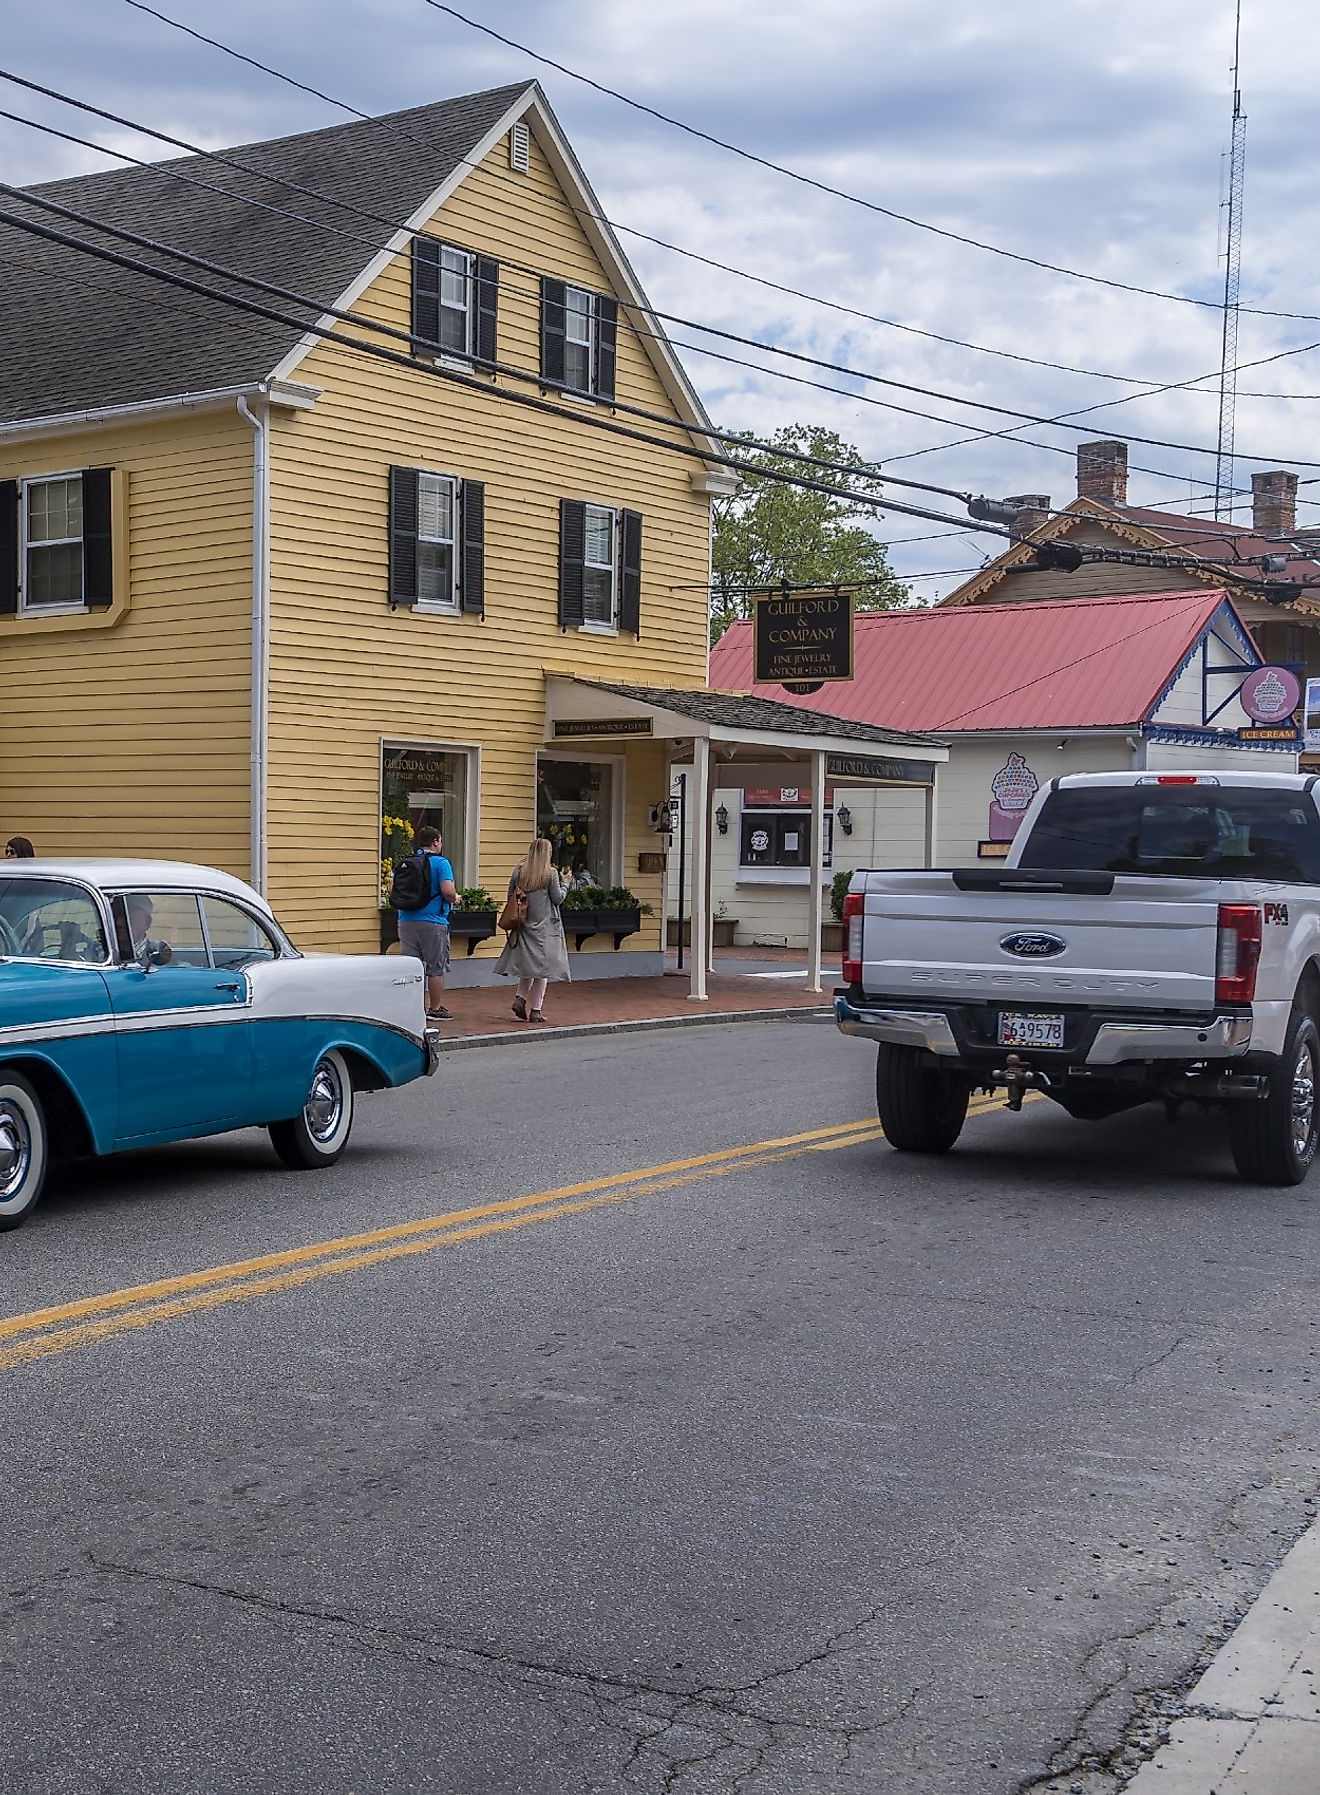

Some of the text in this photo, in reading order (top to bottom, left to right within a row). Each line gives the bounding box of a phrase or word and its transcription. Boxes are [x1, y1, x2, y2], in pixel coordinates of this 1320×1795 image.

[768, 599, 840, 615] GUILFORD
[797, 615, 808, 626] &
[768, 627, 837, 643] COMPANY
[773, 653, 831, 665] FINE JEWELRY
[1242, 730, 1295, 739] ICE CREAM
[1264, 903, 1289, 924] FX4
[1014, 937, 1049, 952] Ford
[911, 971, 1160, 992] SUPER DUTY
